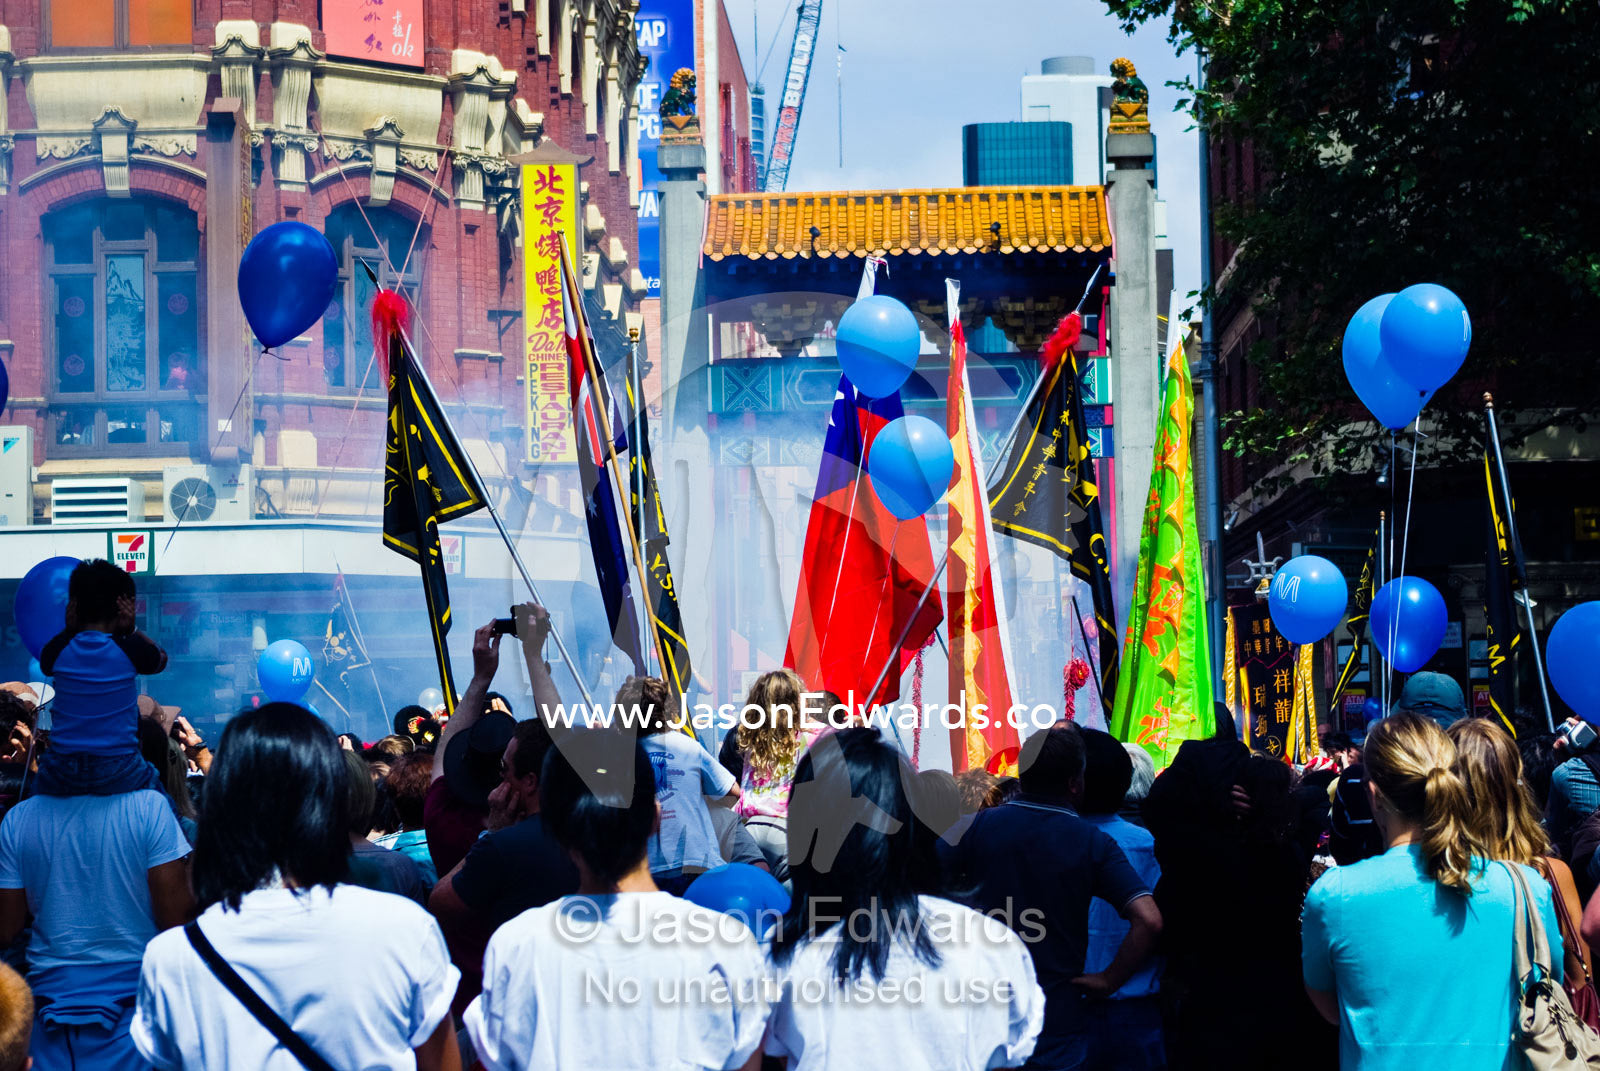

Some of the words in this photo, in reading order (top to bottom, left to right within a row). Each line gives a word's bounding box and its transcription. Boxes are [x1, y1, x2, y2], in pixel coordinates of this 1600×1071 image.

[528, 352, 568, 362] CHINES
[529, 362, 541, 460] PEKING
[539, 362, 568, 461] RESTAURANT
[117, 534, 145, 573] 7
